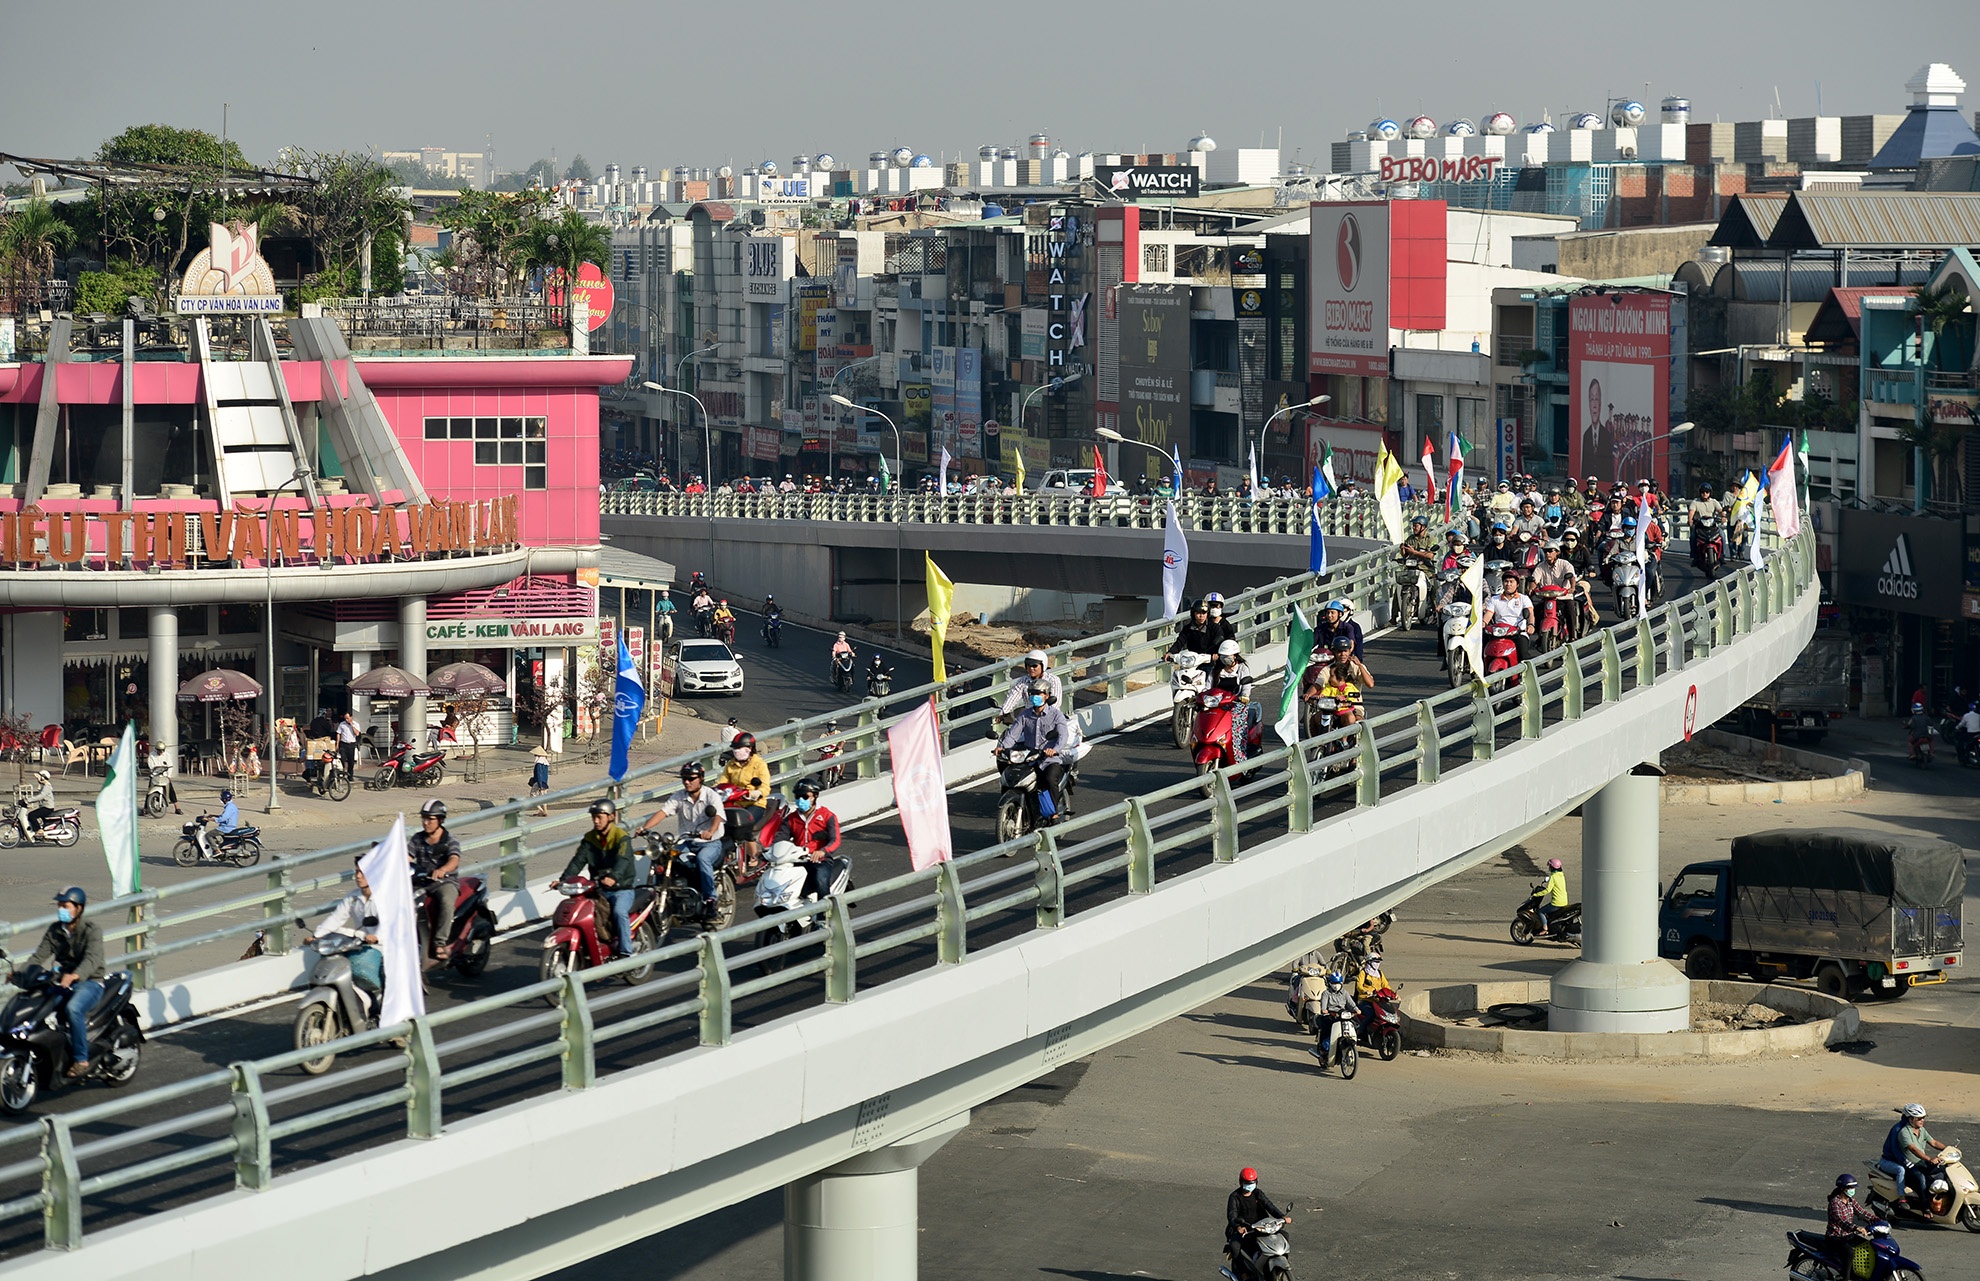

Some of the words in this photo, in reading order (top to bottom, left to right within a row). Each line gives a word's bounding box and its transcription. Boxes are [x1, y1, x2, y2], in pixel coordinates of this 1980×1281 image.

[1380, 157, 1437, 182] BIBO
[1442, 156, 1502, 183] MART
[762, 180, 807, 197] UE
[1131, 173, 1192, 188] WATCH
[748, 242, 776, 277] BLUE
[571, 289, 591, 303] afe
[749, 282, 776, 295] EXCHANGE
[181, 299, 194, 310] CTY
[197, 299, 207, 310] CP
[226, 297, 241, 310] HÓA
[260, 299, 280, 310] LANG
[806, 299, 823, 311] KIM
[1049, 242, 1065, 366] WATCH
[1326, 300, 1347, 330] BIBO
[1348, 300, 1373, 332] MART
[1572, 307, 1596, 339] NGOẠI
[1616, 305, 1644, 334] DƯƠNG
[1646, 311, 1667, 335] MINH
[818, 344, 835, 359] HOÀI
[1586, 341, 1603, 356] THÀNH
[1638, 346, 1652, 359] 1990
[819, 366, 835, 379] ANH
[945, 413, 954, 421] 56
[1136, 403, 1168, 450] Suboy
[1505, 424, 1514, 442] GO
[1353, 450, 1378, 484] MART
[1505, 455, 1515, 480] HOP
[0, 503, 87, 562] IÊU
[99, 510, 187, 570] THỊ
[200, 501, 299, 562] VĂN
[315, 497, 402, 558] HÓA
[408, 494, 471, 552] VĂN
[475, 494, 519, 548] LANG
[1877, 574, 1918, 599] adidas
[427, 621, 467, 639] CAFÉ
[476, 624, 508, 638] KEM
[510, 621, 540, 637] VĂN
[542, 622, 585, 636] LANG
[631, 629, 642, 639] BÒ
